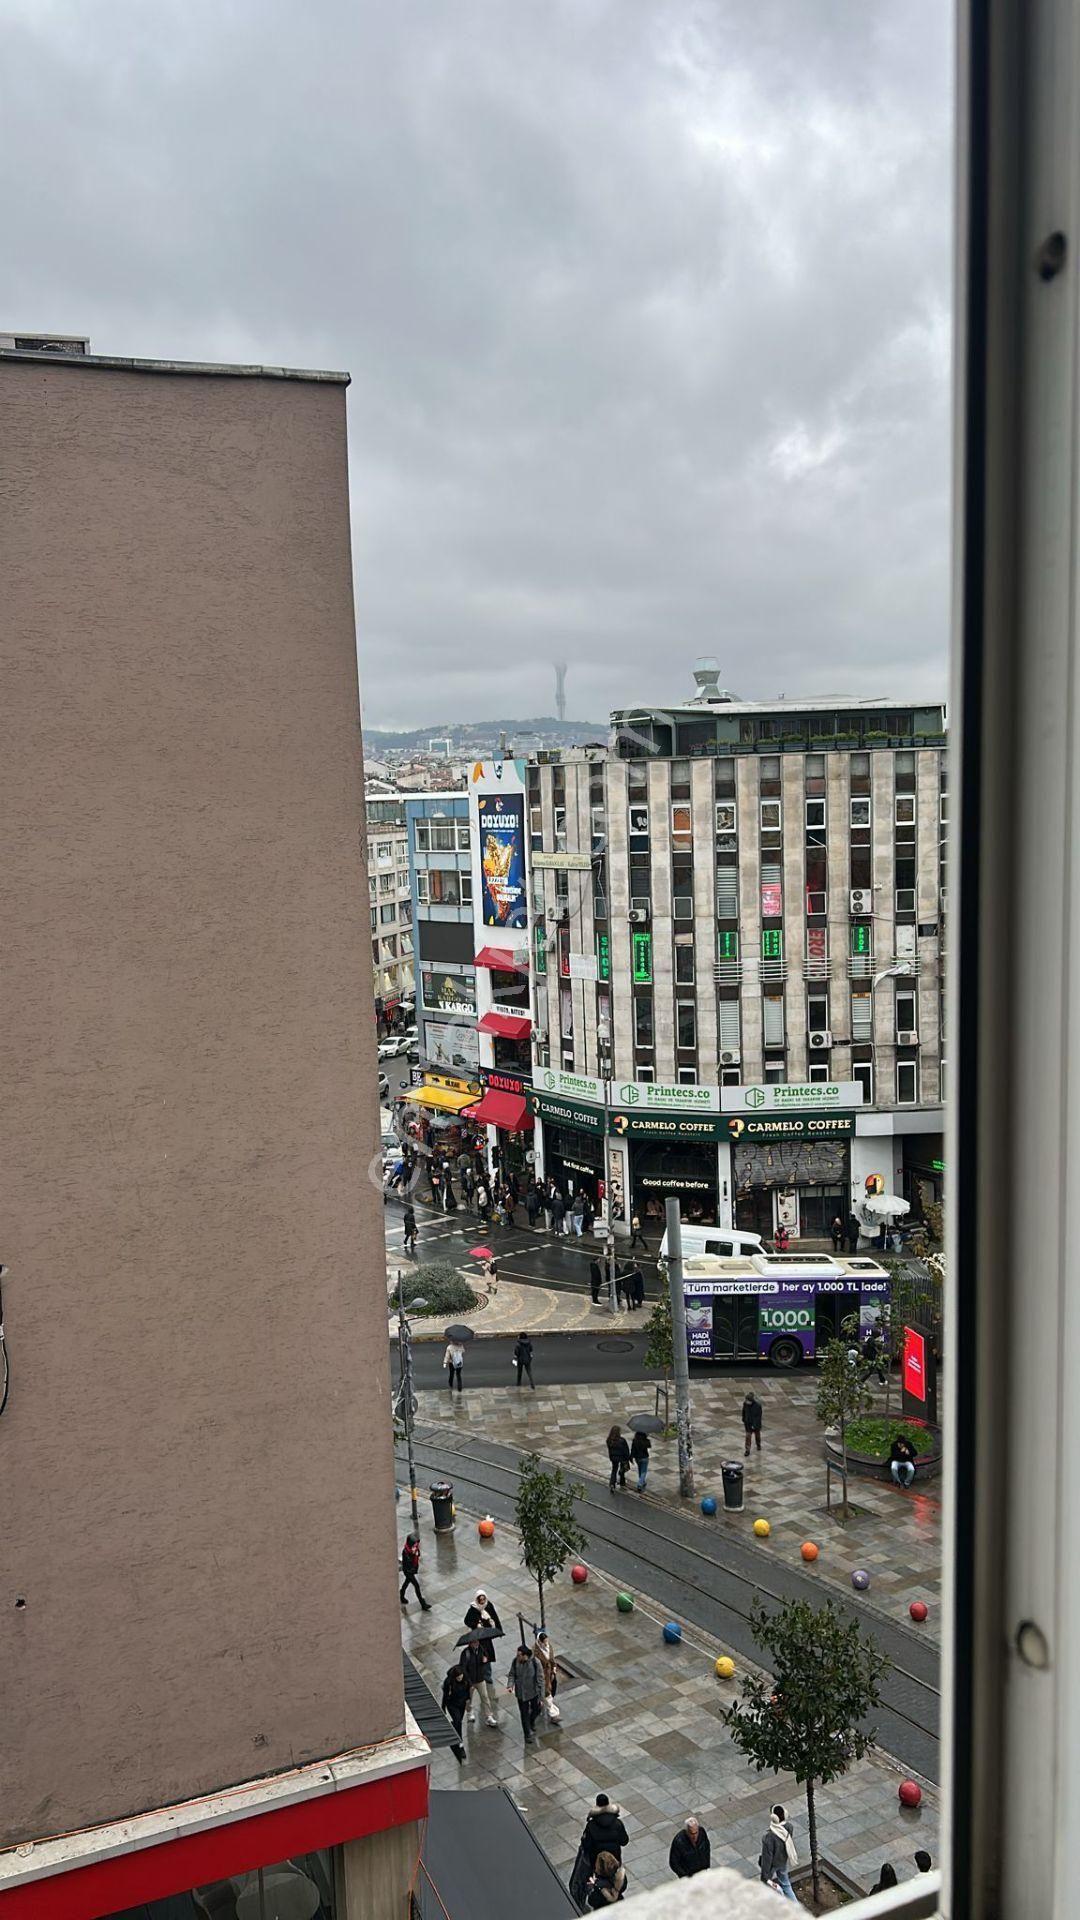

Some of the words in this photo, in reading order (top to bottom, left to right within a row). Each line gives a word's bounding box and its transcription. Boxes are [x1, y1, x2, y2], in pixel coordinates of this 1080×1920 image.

[445, 1001, 474, 1013] KARGO
[647, 1085, 710, 1098] Printecs.co
[773, 1086, 839, 1097] Printecs.co
[541, 1103, 572, 1118] CARMELO
[574, 1112, 599, 1126] COFFEE
[631, 1120, 676, 1130] CARMELO
[679, 1122, 716, 1132] COFFEE
[747, 1121, 804, 1132] CARMELO
[808, 1119, 852, 1130] COFFEE
[643, 1178, 661, 1187] Good
[685, 1181, 709, 1189] before
[688, 1284, 709, 1292] Tüm
[713, 1283, 775, 1292] marketlerde
[782, 1282, 799, 1291] her
[802, 1284, 815, 1293] ay
[818, 1282, 844, 1291] 1.000
[847, 1282, 859, 1291] TL
[862, 1282, 886, 1291] iade!
[692, 1331, 709, 1339] HADİ
